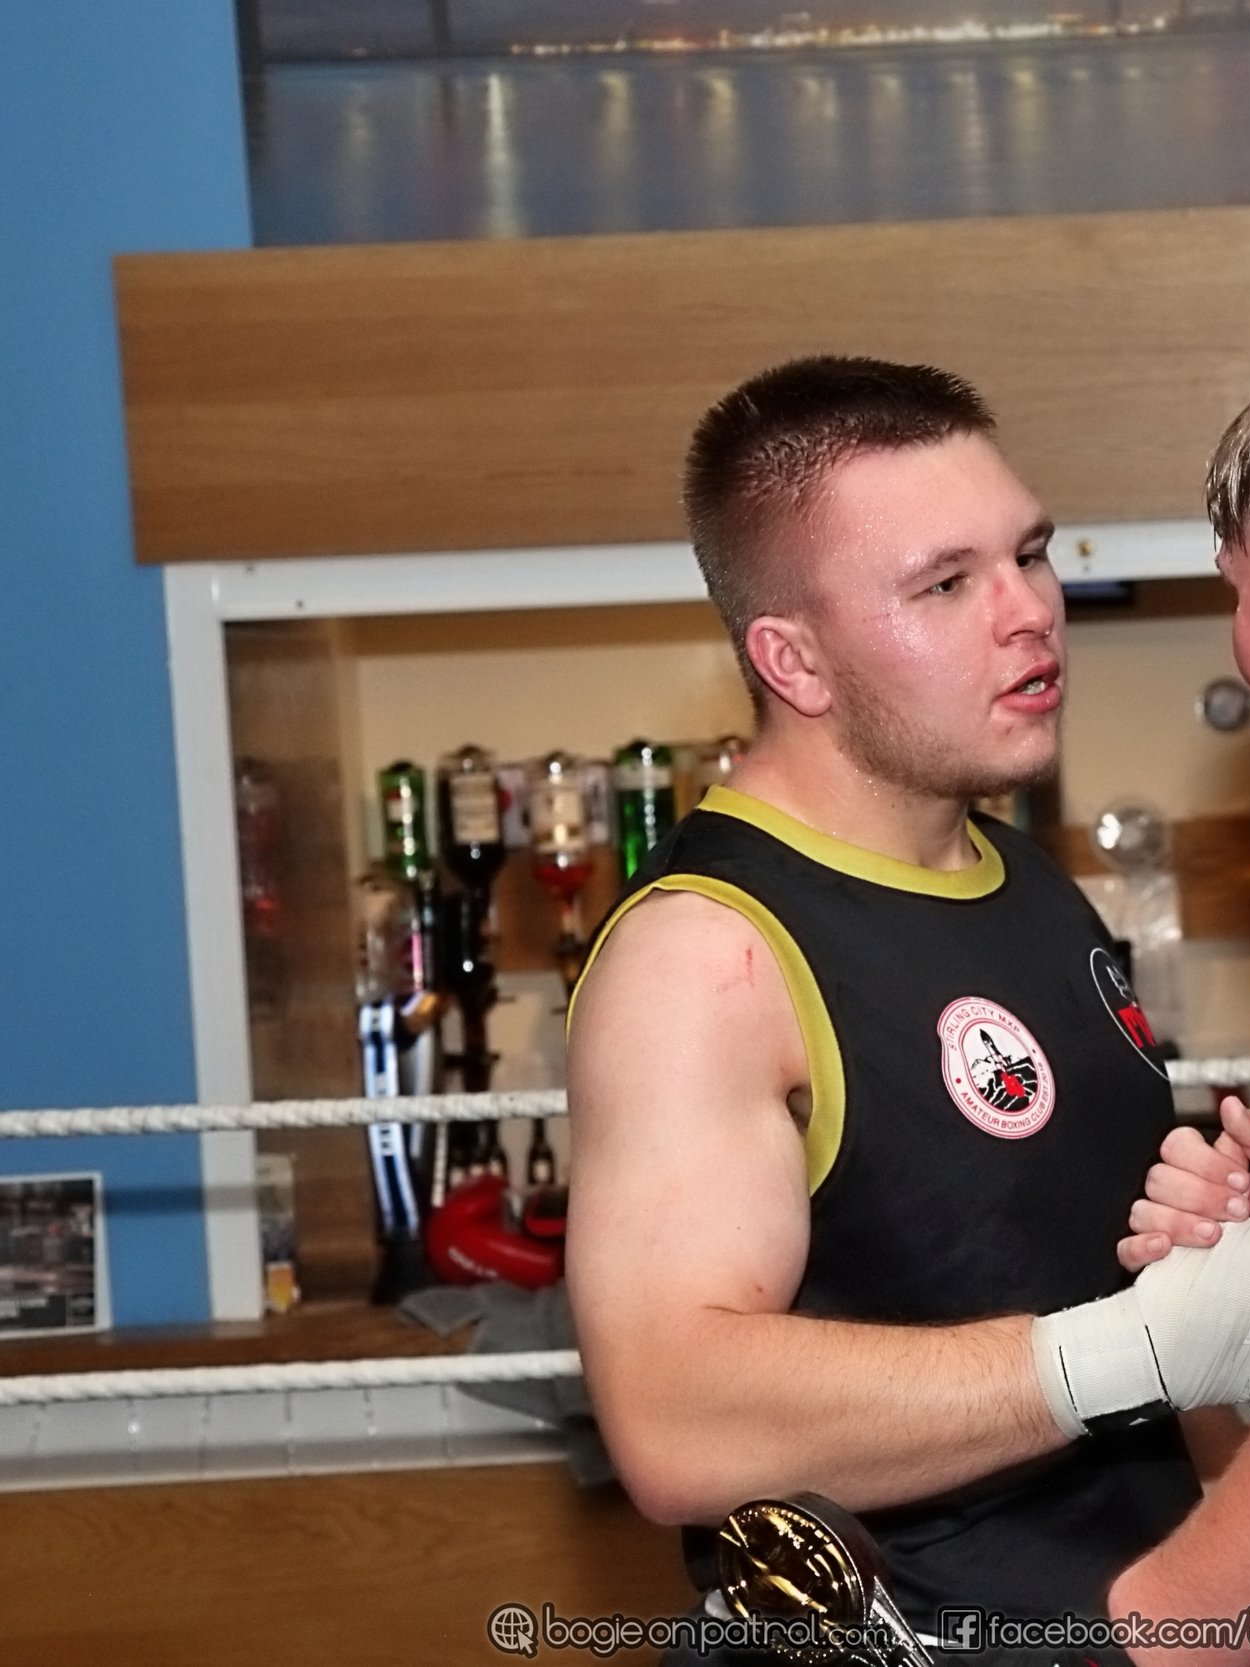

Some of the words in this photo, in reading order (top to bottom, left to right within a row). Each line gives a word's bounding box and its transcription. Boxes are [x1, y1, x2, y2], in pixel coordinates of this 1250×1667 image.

[946, 1008, 971, 1051] STIRLING
[970, 1006, 994, 1017] CITY
[961, 1091, 1000, 1127] AMATEUR
[1001, 1117, 1031, 1130] BOXING
[1031, 1102, 1046, 1121] CLUB
